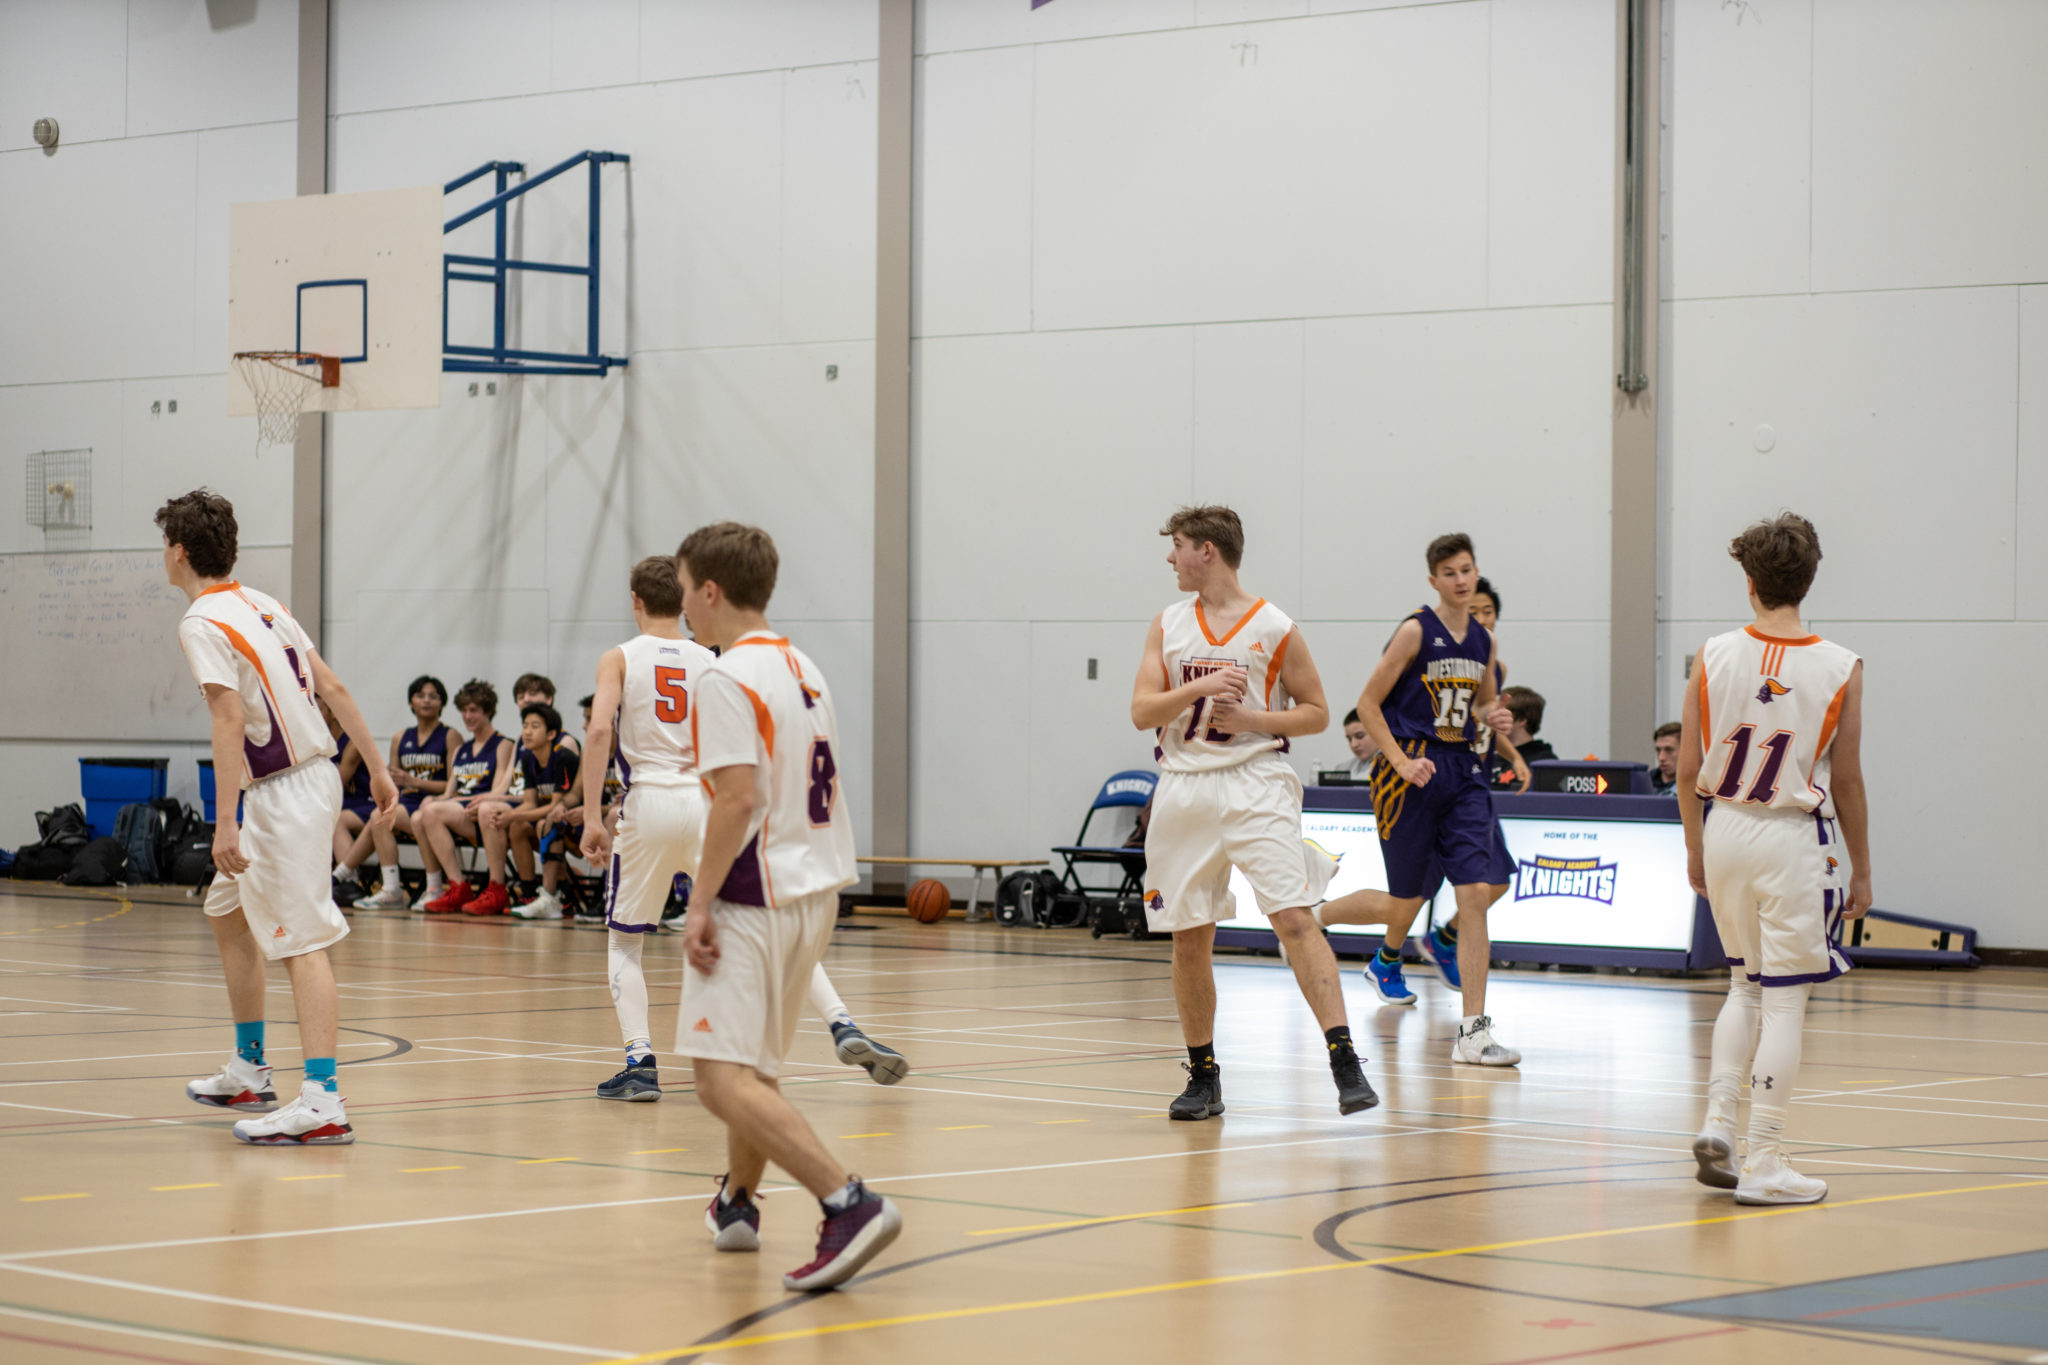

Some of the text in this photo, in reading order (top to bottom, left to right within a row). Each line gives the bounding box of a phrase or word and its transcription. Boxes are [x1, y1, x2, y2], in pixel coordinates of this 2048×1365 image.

[654, 664, 689, 724] 5
[1432, 687, 1473, 728] 15
[806, 735, 838, 829] 8
[1712, 723, 1796, 806] 11
[1106, 778, 1154, 796] KNIGHTS
[1566, 776, 1597, 793] POSS
[1570, 832, 1580, 840] OF
[1517, 864, 1615, 902] KNIGHTS
